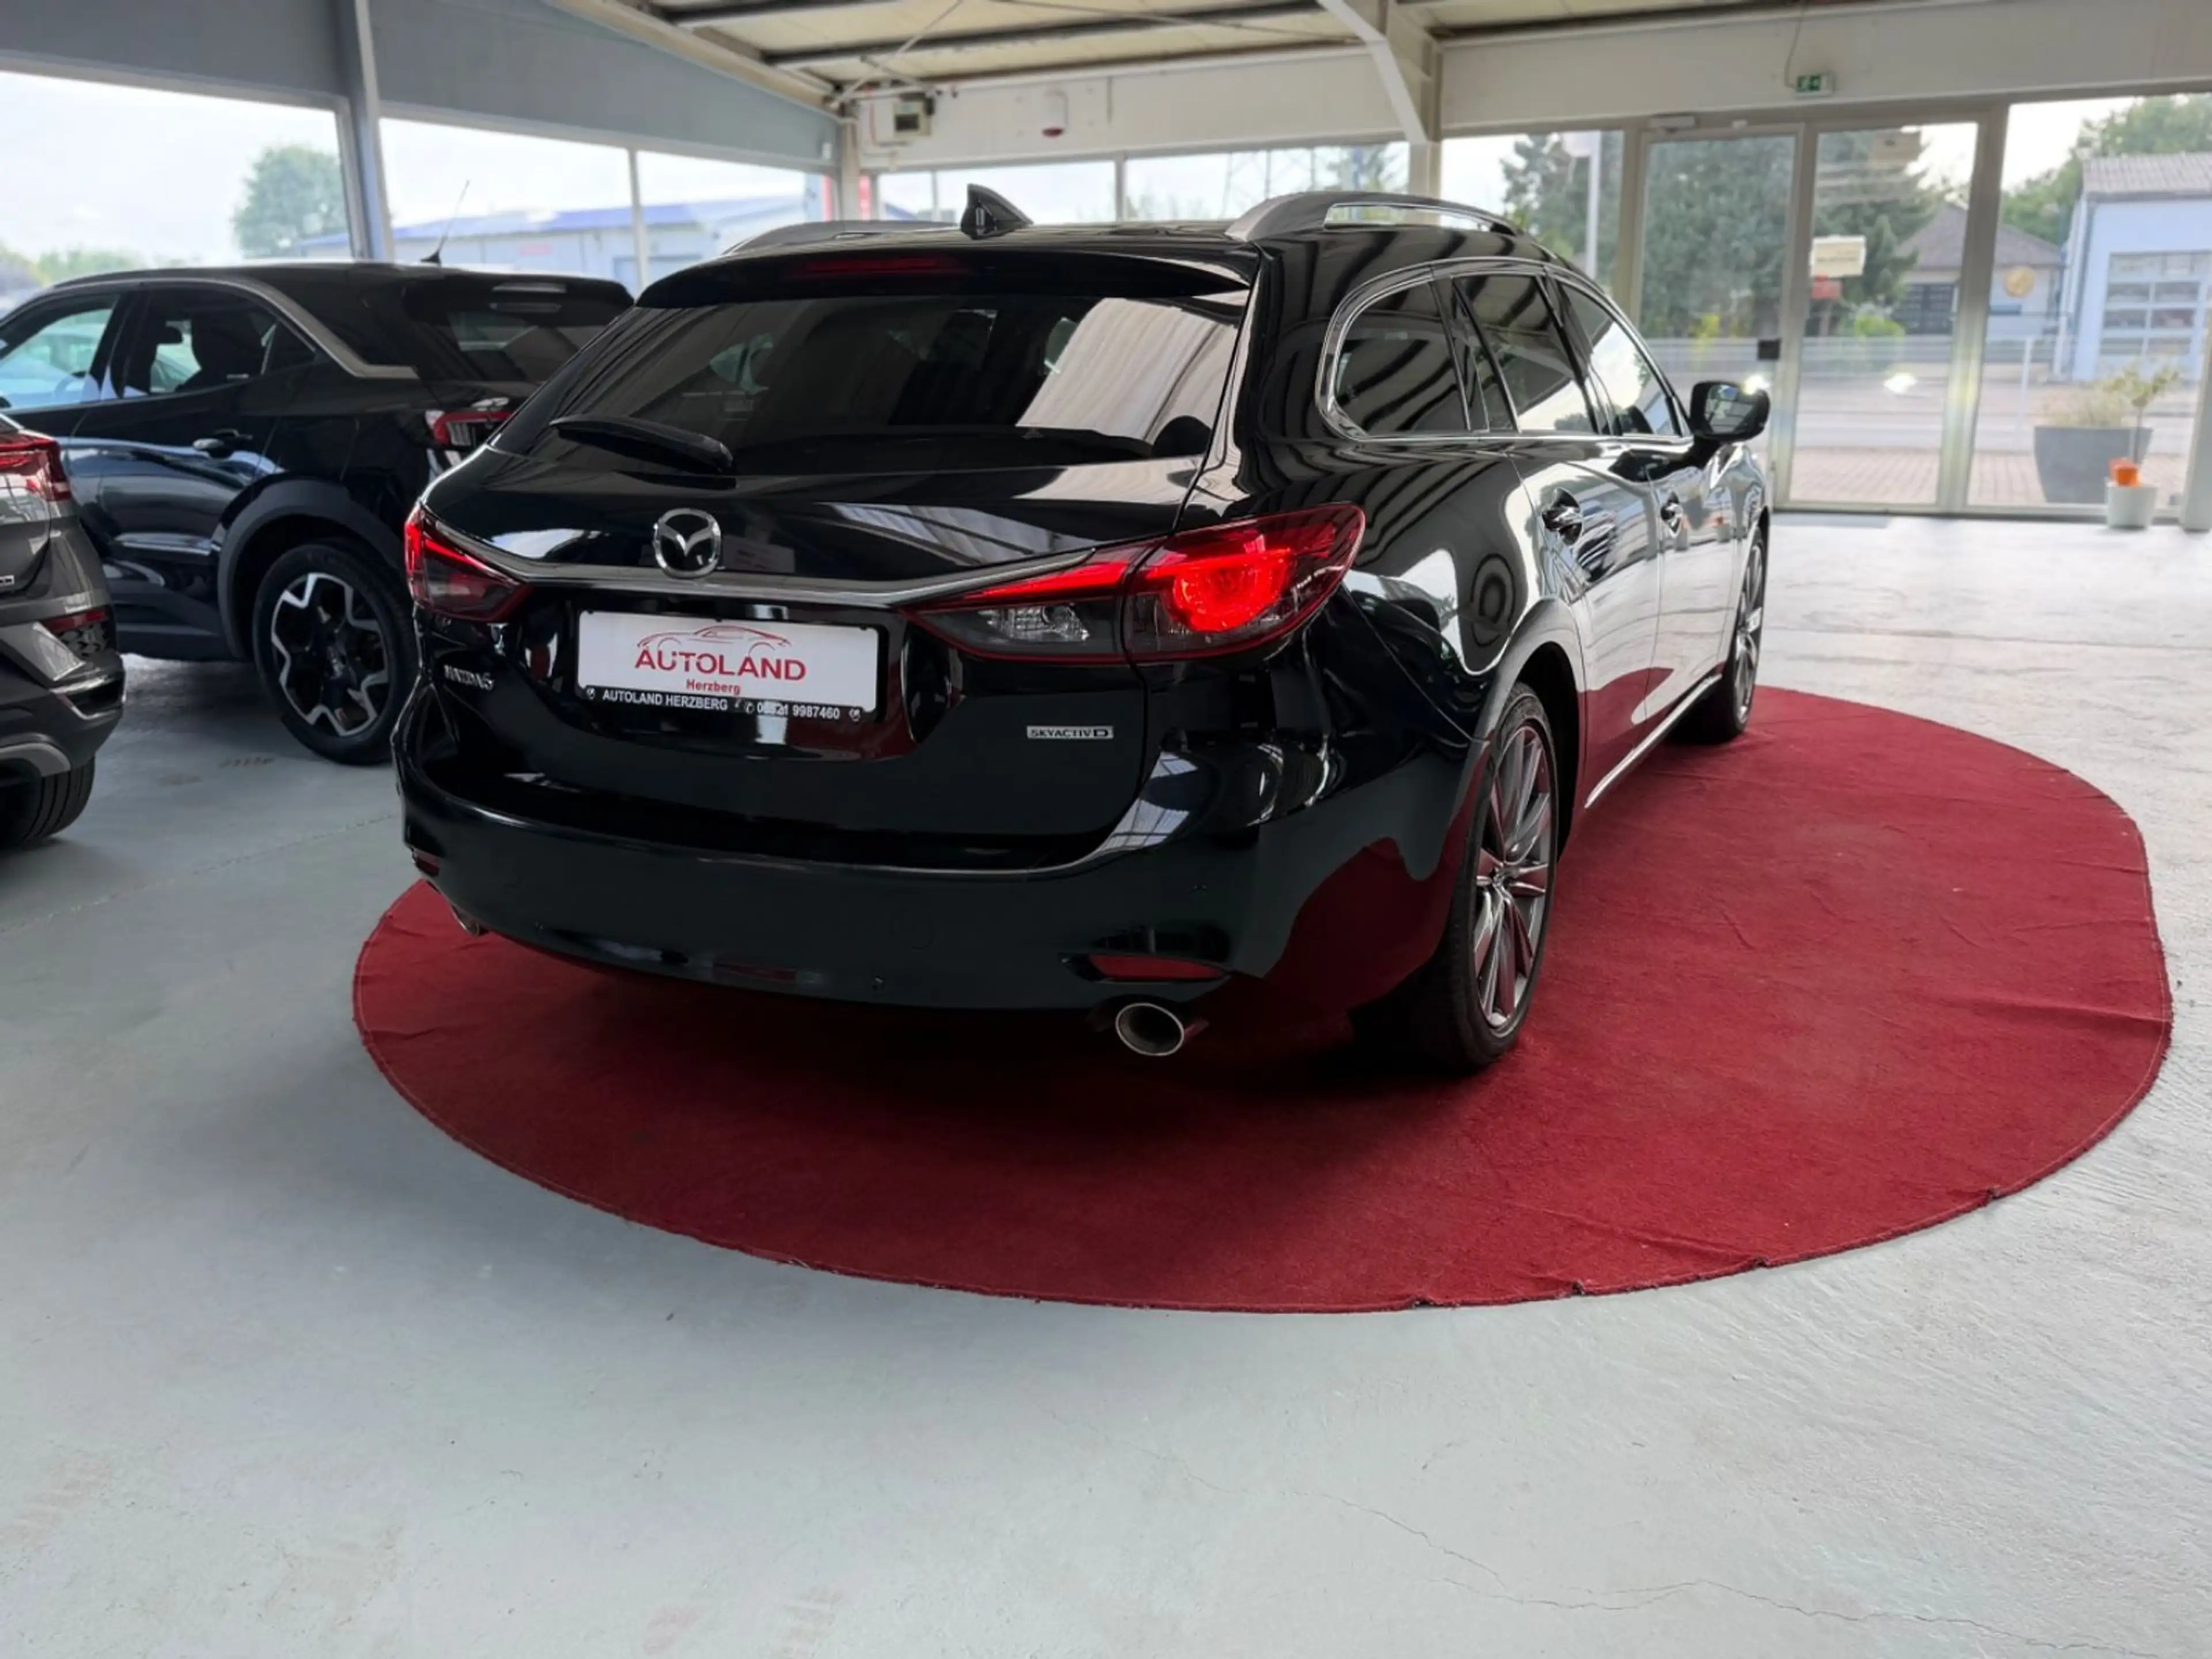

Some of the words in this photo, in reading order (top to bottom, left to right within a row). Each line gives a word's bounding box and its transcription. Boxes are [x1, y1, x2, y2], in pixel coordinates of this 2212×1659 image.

[634, 649, 806, 680] AUTOLAND
[686, 679, 741, 695] Herzberg
[603, 690, 663, 706] AUTOLAND
[666, 695, 728, 710] HERZBERG
[792, 704, 840, 719] 9987460
